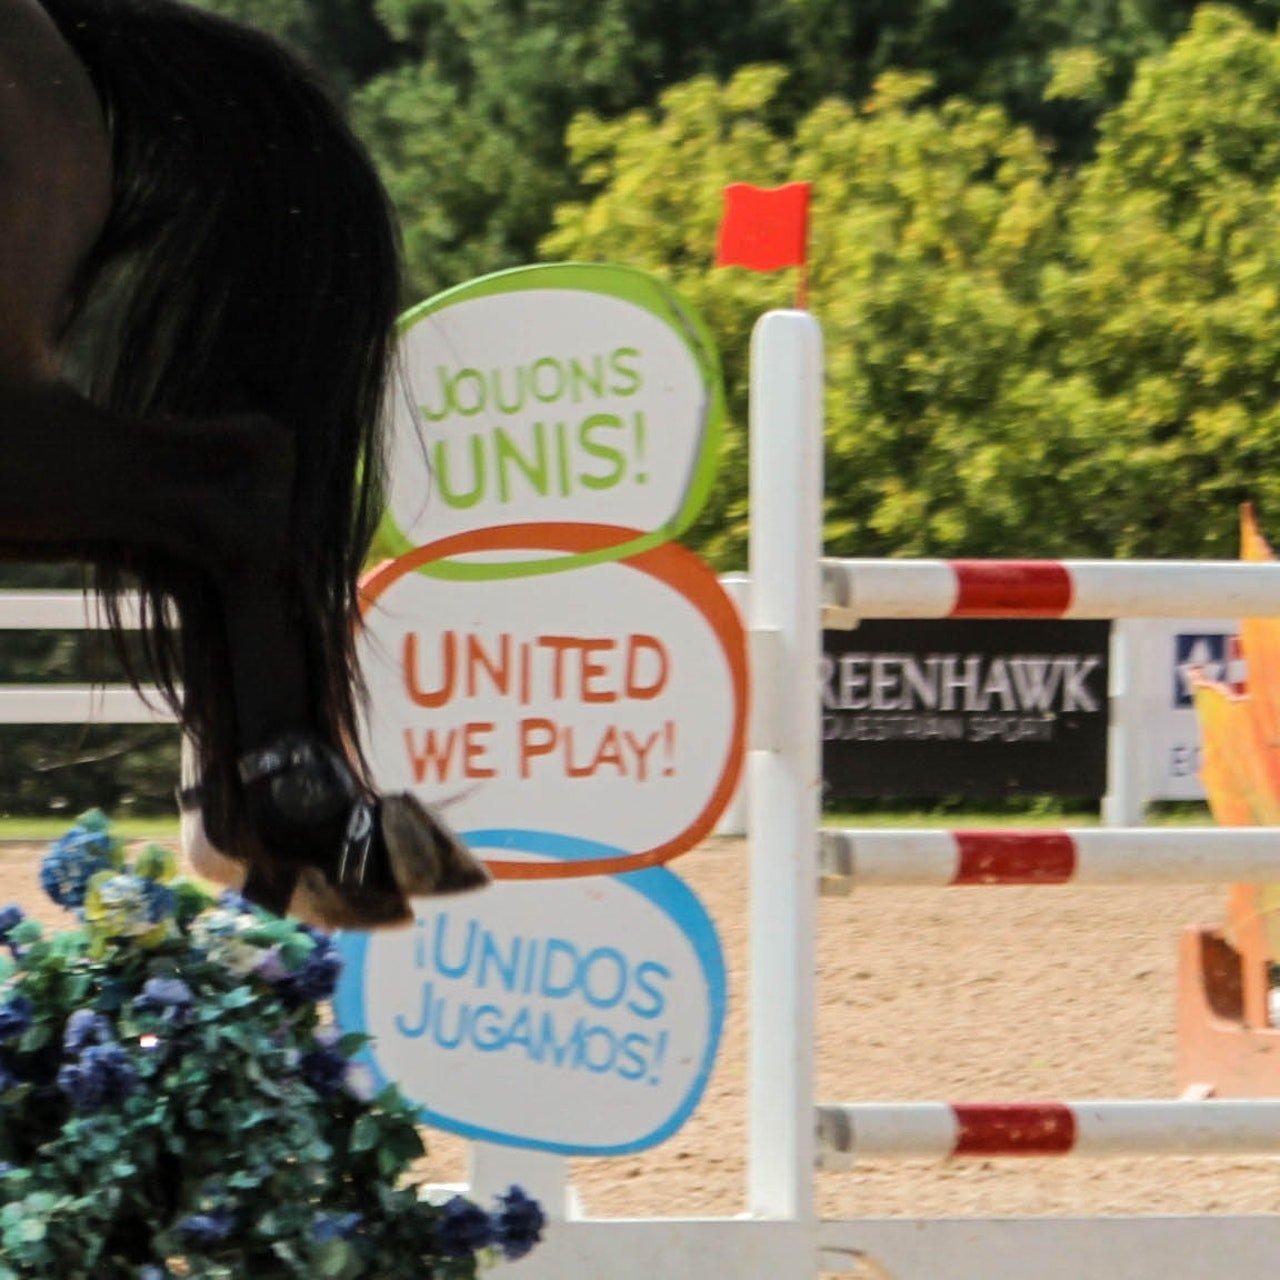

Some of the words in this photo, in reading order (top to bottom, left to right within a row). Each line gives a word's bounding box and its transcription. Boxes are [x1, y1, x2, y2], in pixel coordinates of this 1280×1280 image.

[420, 347, 642, 422] JOUONS
[434, 412, 649, 508] UNIS!
[402, 630, 671, 709] UNITED
[821, 651, 1102, 713] REENHAWK
[403, 721, 496, 784] WE
[518, 717, 677, 782] PLAY!
[414, 913, 674, 1020] ¡UNIDOS
[395, 982, 669, 1087] JUGAMOS!
